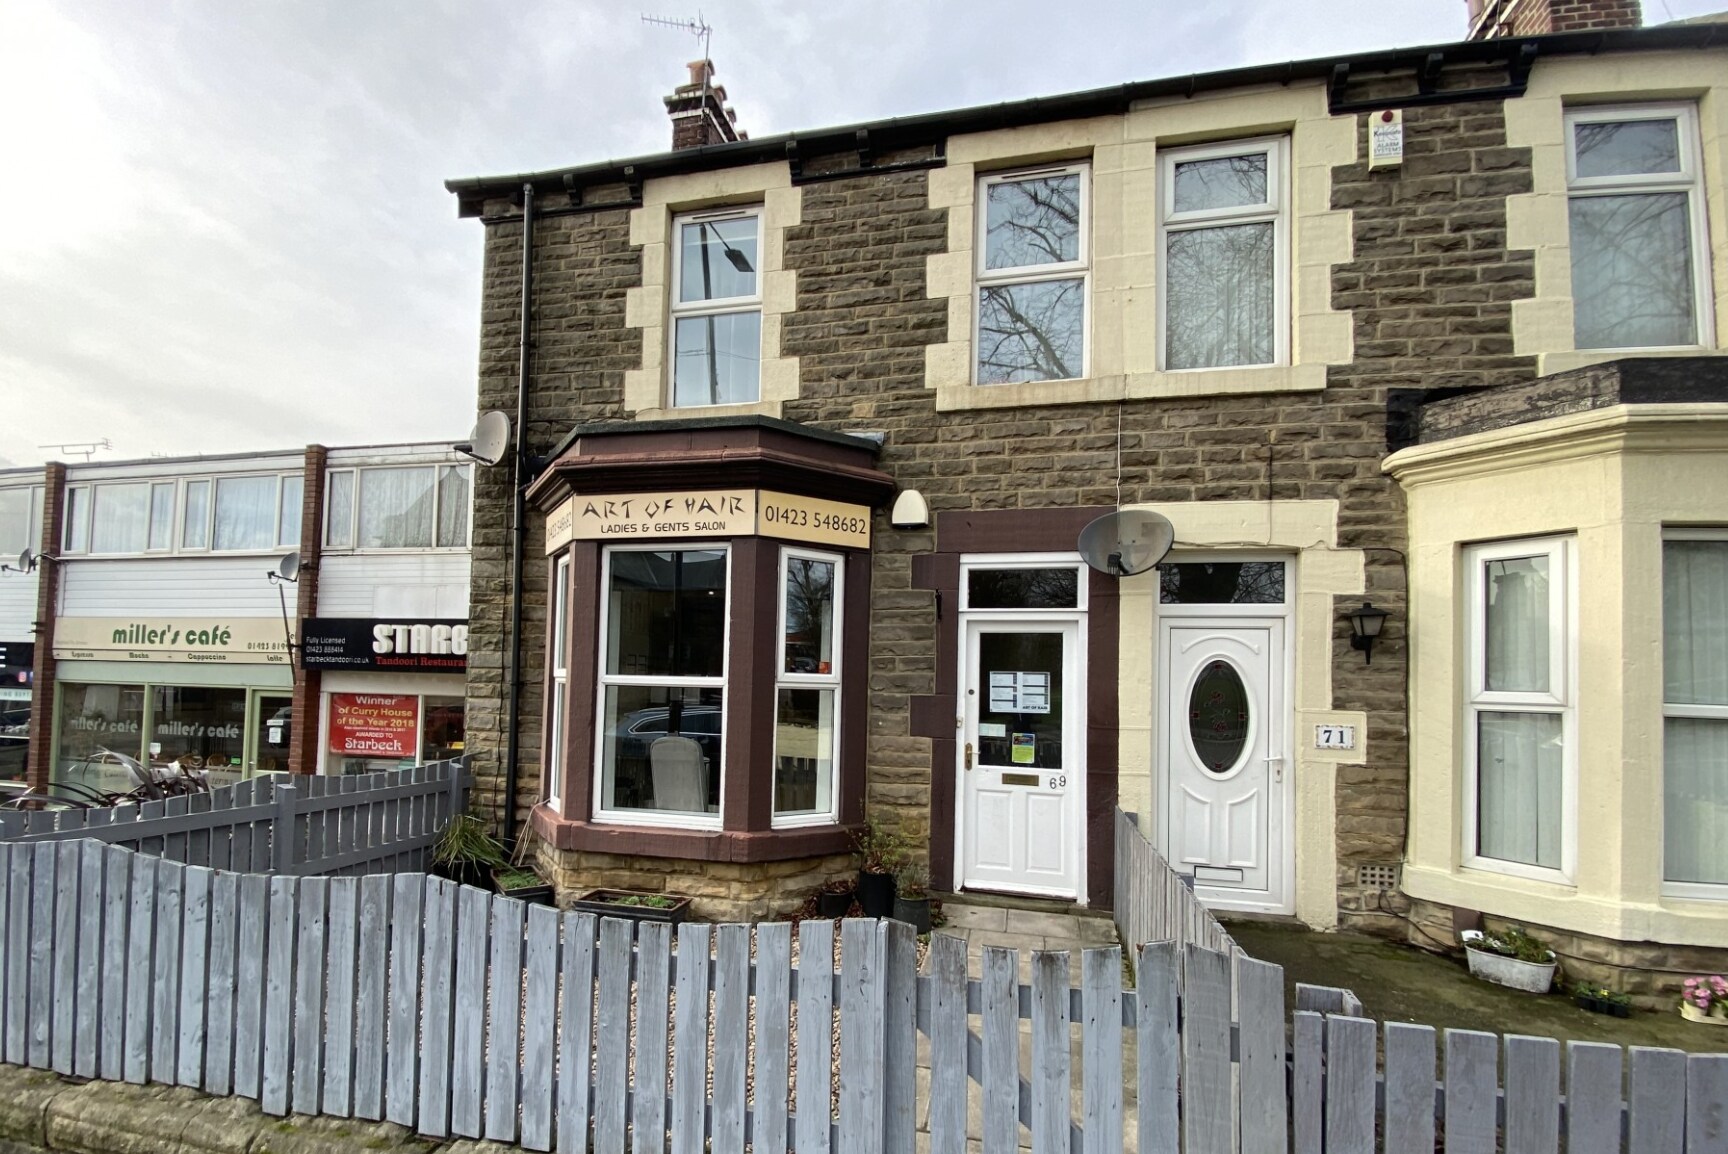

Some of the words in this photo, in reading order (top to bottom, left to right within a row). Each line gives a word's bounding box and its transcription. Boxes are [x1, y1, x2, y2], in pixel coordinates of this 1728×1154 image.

[582, 499, 635, 519] ART
[645, 498, 674, 519] OF
[685, 496, 746, 516] HAIR
[765, 505, 807, 526] 01423
[813, 512, 866, 534] 548682
[601, 523, 638, 534] LADIES
[642, 523, 650, 532] &
[654, 522, 690, 532] GENTS
[695, 520, 726, 531] SALON
[112, 623, 180, 645] miller's
[185, 624, 232, 646] café
[306, 637, 319, 645] Fully
[320, 637, 346, 645] Licensed
[372, 623, 469, 655] STARB
[187, 652, 227, 662] Cappuccino
[375, 656, 418, 667] Tandoori
[355, 695, 398, 706] Winner
[338, 706, 349, 714] of
[351, 706, 379, 717] Curry
[381, 708, 413, 717] House
[109, 719, 139, 733] café
[336, 717, 346, 725] of
[348, 717, 364, 726] the
[366, 717, 389, 727] Year
[390, 719, 415, 728] 2018
[158, 721, 206, 737] miller's
[207, 723, 239, 739] café
[355, 731, 385, 739] AWARDED
[1323, 729, 1345, 744] 71
[345, 737, 402, 751] Starbeck
[1049, 775, 1067, 789] 69
